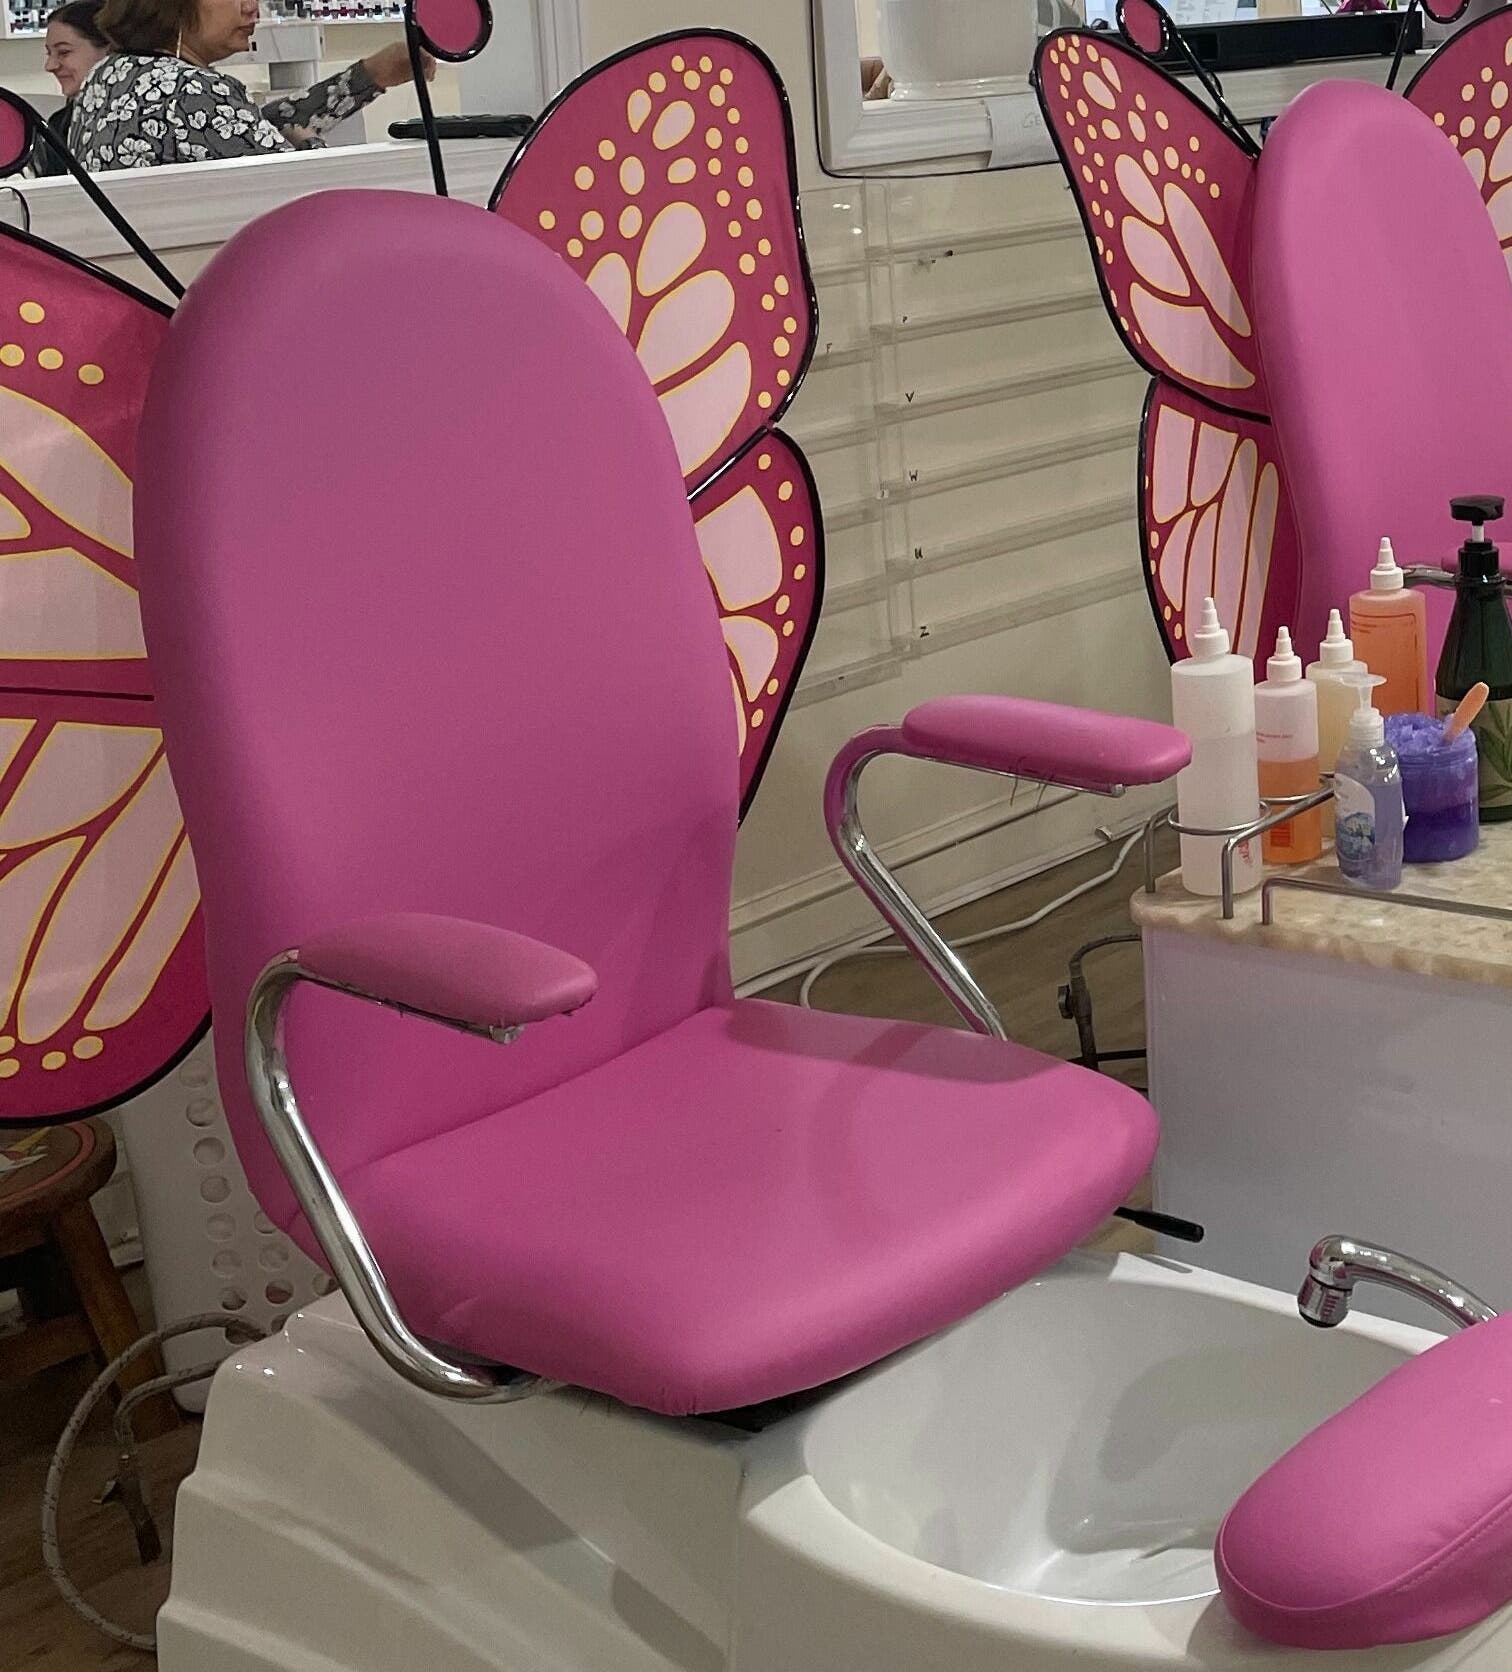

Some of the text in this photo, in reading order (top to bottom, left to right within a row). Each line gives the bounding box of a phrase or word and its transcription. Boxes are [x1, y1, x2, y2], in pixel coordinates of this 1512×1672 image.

[904, 390, 915, 403] V
[908, 469, 919, 482] W
[919, 625, 930, 639] Z
